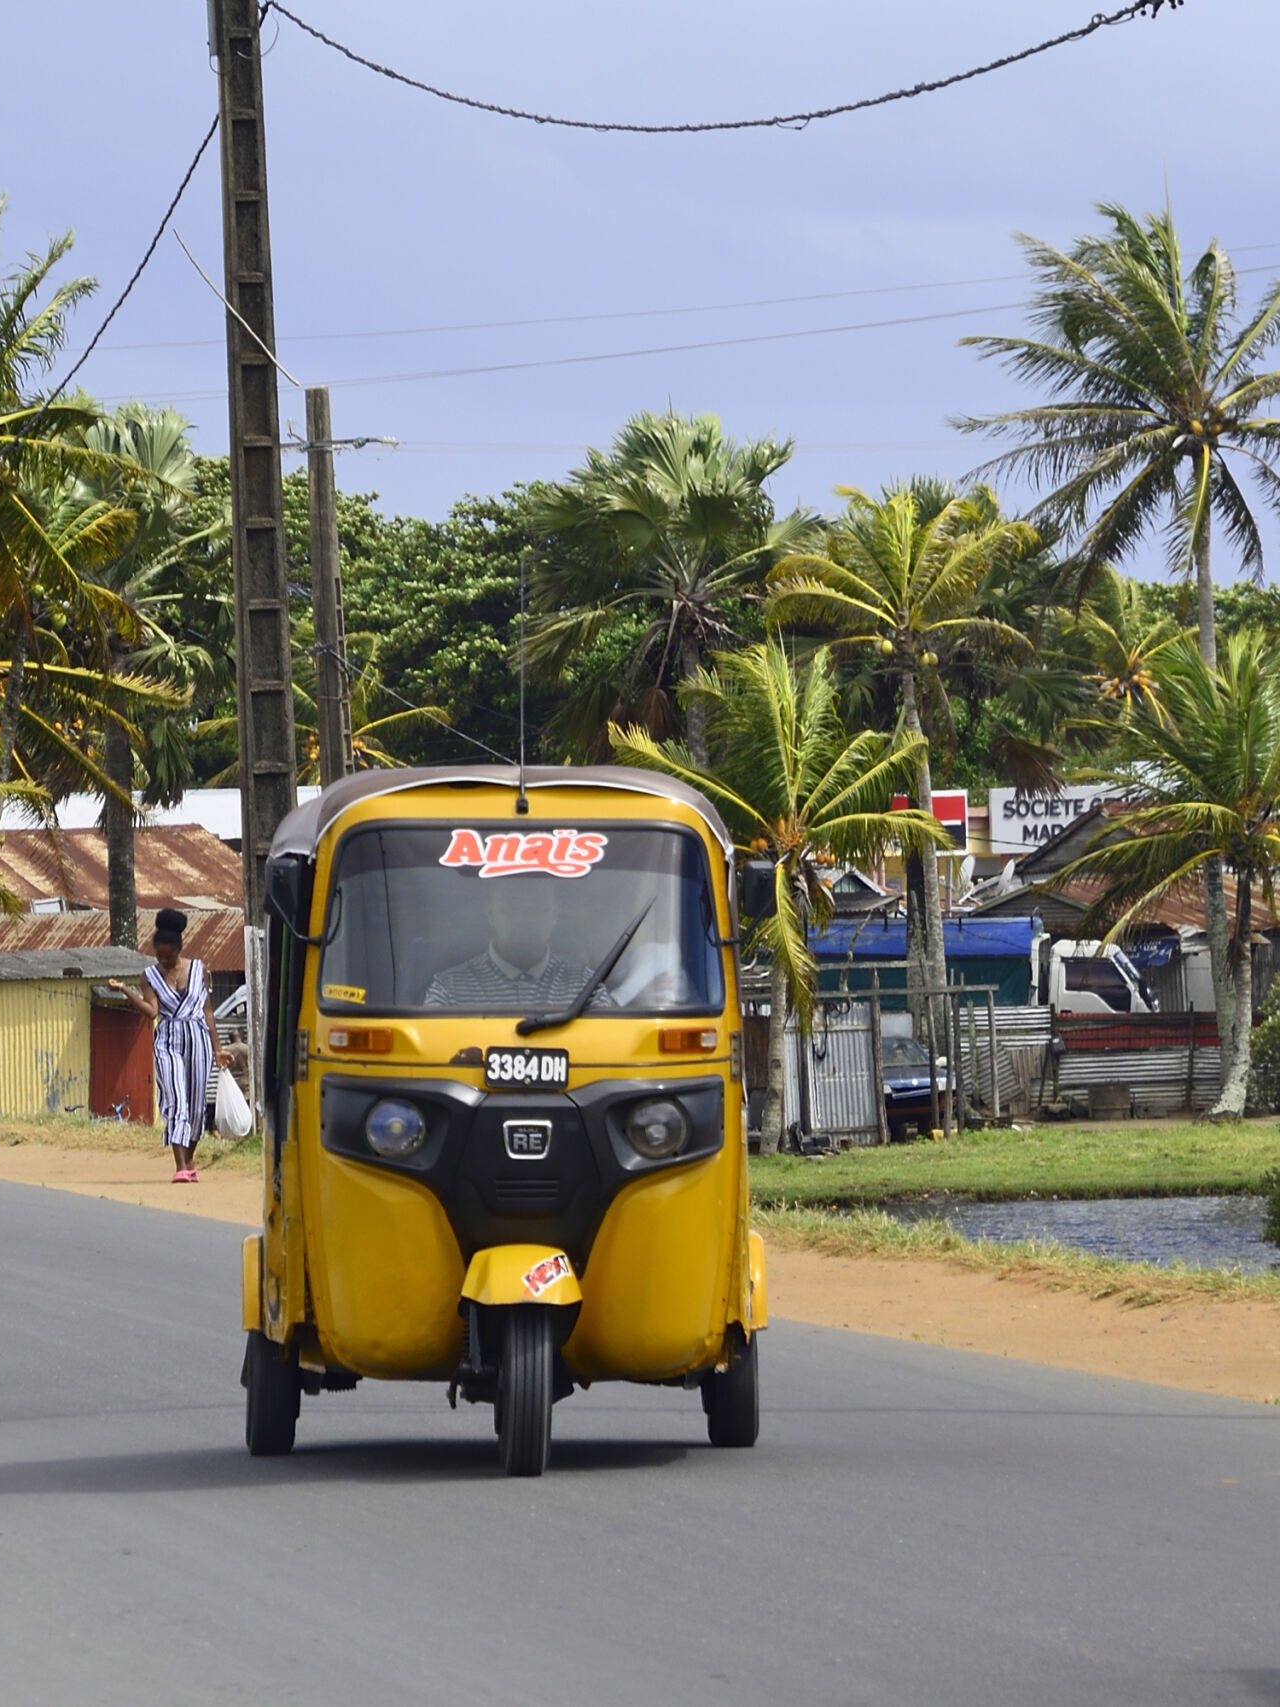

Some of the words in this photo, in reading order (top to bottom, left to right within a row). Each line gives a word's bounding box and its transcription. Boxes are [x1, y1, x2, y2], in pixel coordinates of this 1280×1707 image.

[1003, 798, 1084, 819] SOCIETE
[439, 829, 607, 878] Anaïs
[487, 1053, 539, 1081] 3384
[541, 1056, 567, 1082] DH
[513, 1133, 542, 1151] RE
